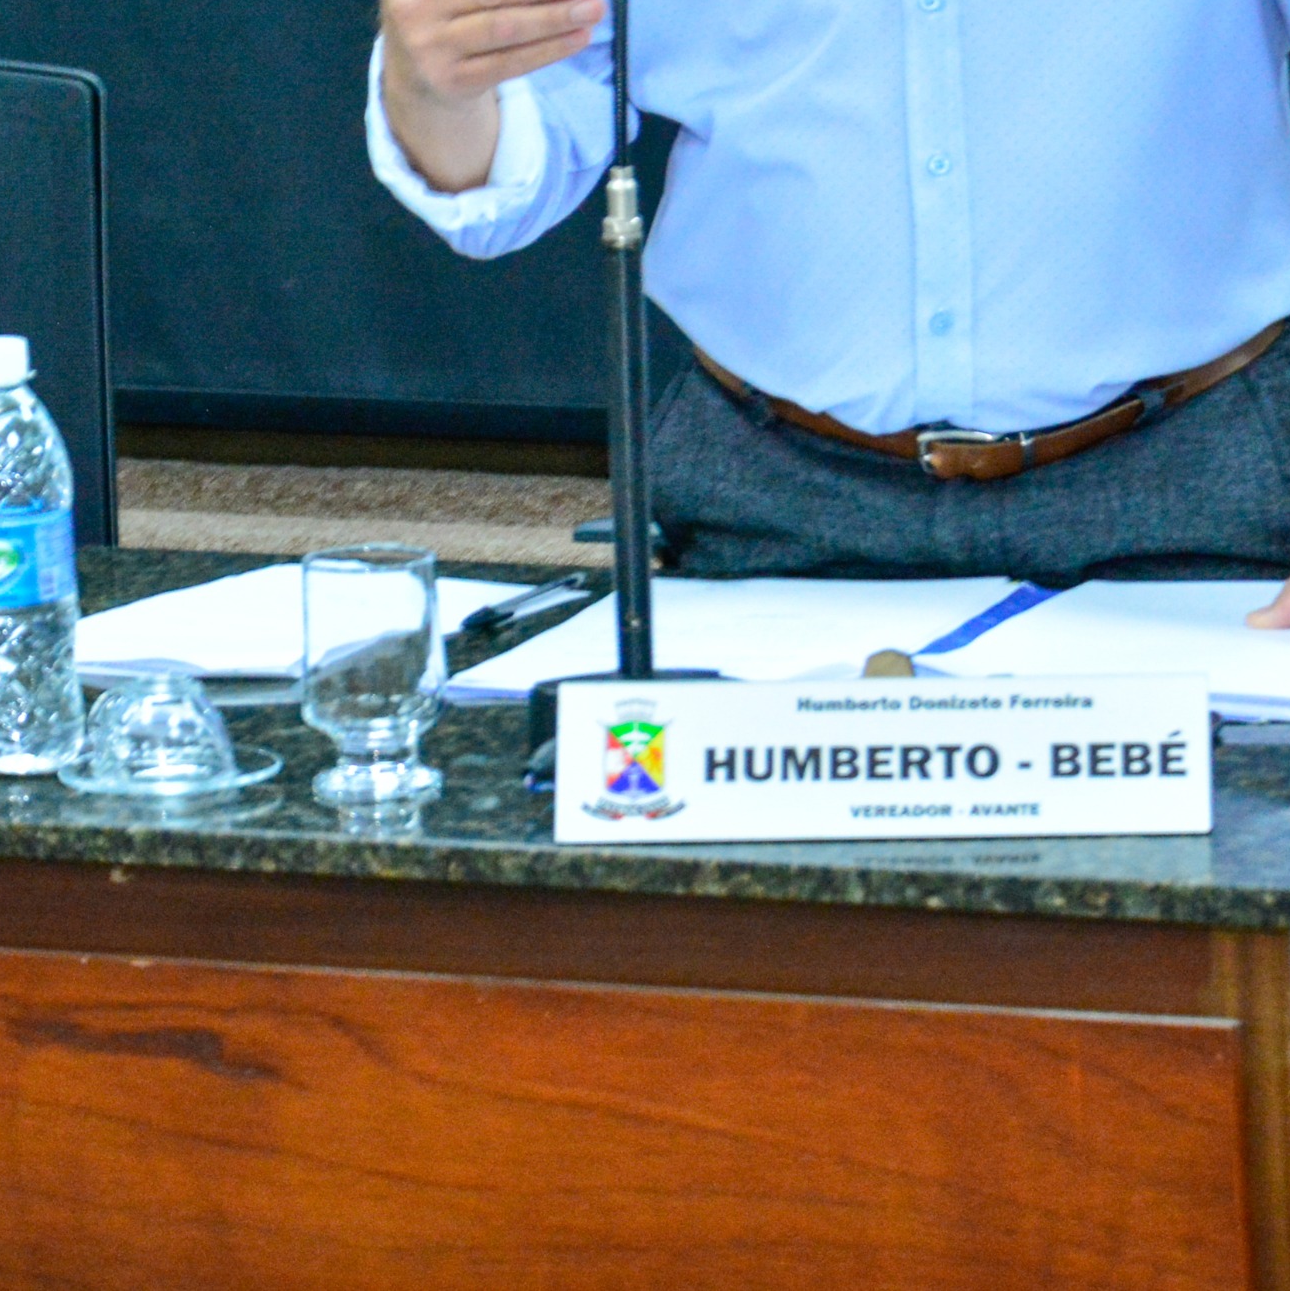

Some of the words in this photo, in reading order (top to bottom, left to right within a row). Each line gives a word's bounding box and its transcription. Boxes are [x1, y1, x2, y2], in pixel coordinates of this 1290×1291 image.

[797, 696, 902, 712] Humberto
[704, 743, 1001, 783] HUMBERTO
[1049, 729, 1188, 779] BEBÉ
[850, 803, 953, 819] VEREADOR
[969, 802, 1041, 818] AVANTE
